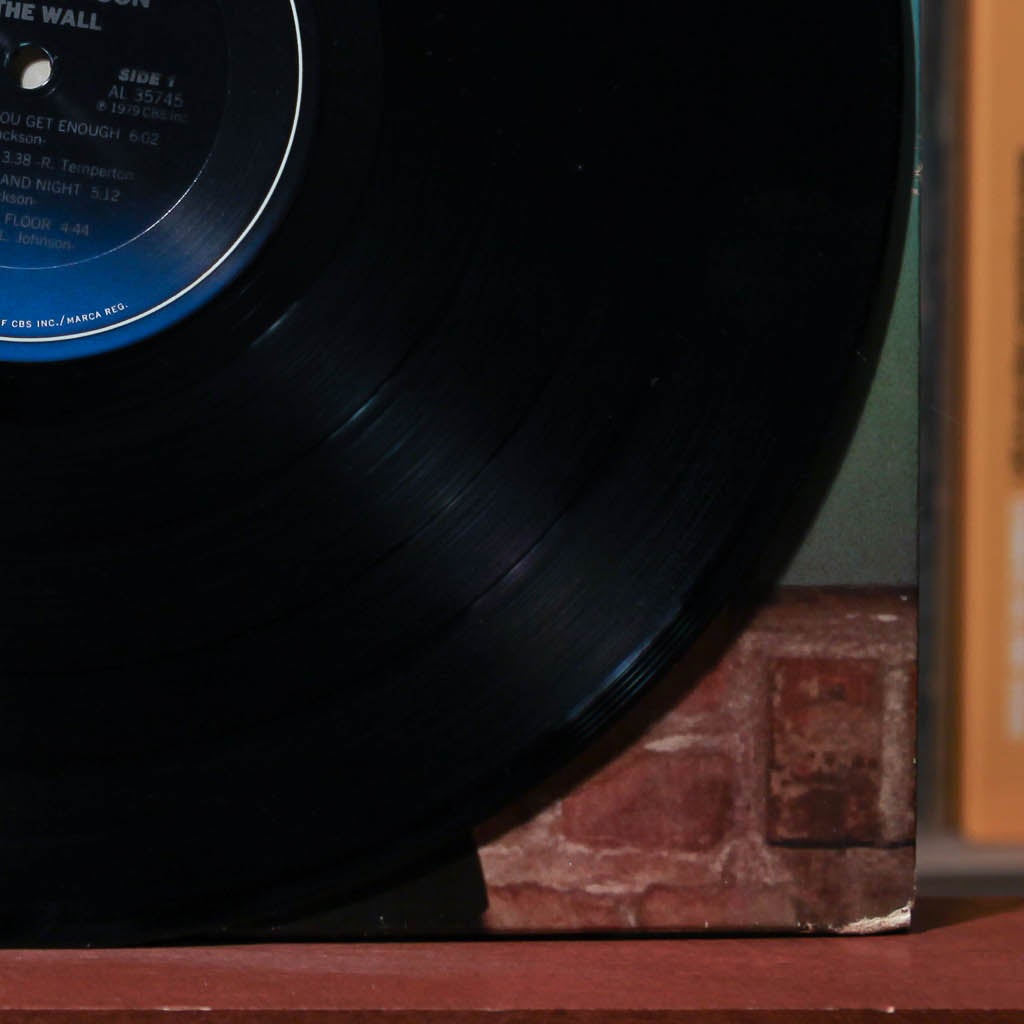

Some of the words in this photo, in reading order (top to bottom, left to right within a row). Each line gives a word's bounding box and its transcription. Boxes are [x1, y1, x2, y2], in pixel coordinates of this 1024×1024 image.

[41, 3, 103, 32] WALL
[118, 68, 161, 86] SIDE
[108, 84, 128, 100] AL
[134, 87, 184, 108] 35745
[25, 114, 53, 129] GET
[58, 119, 121, 140] ENOUGH
[0, 173, 32, 189] AND
[36, 179, 80, 196] NIGHT
[4, 212, 51, 230] FLOOR
[11, 320, 32, 328] CBS
[104, 302, 129, 316] REG.
